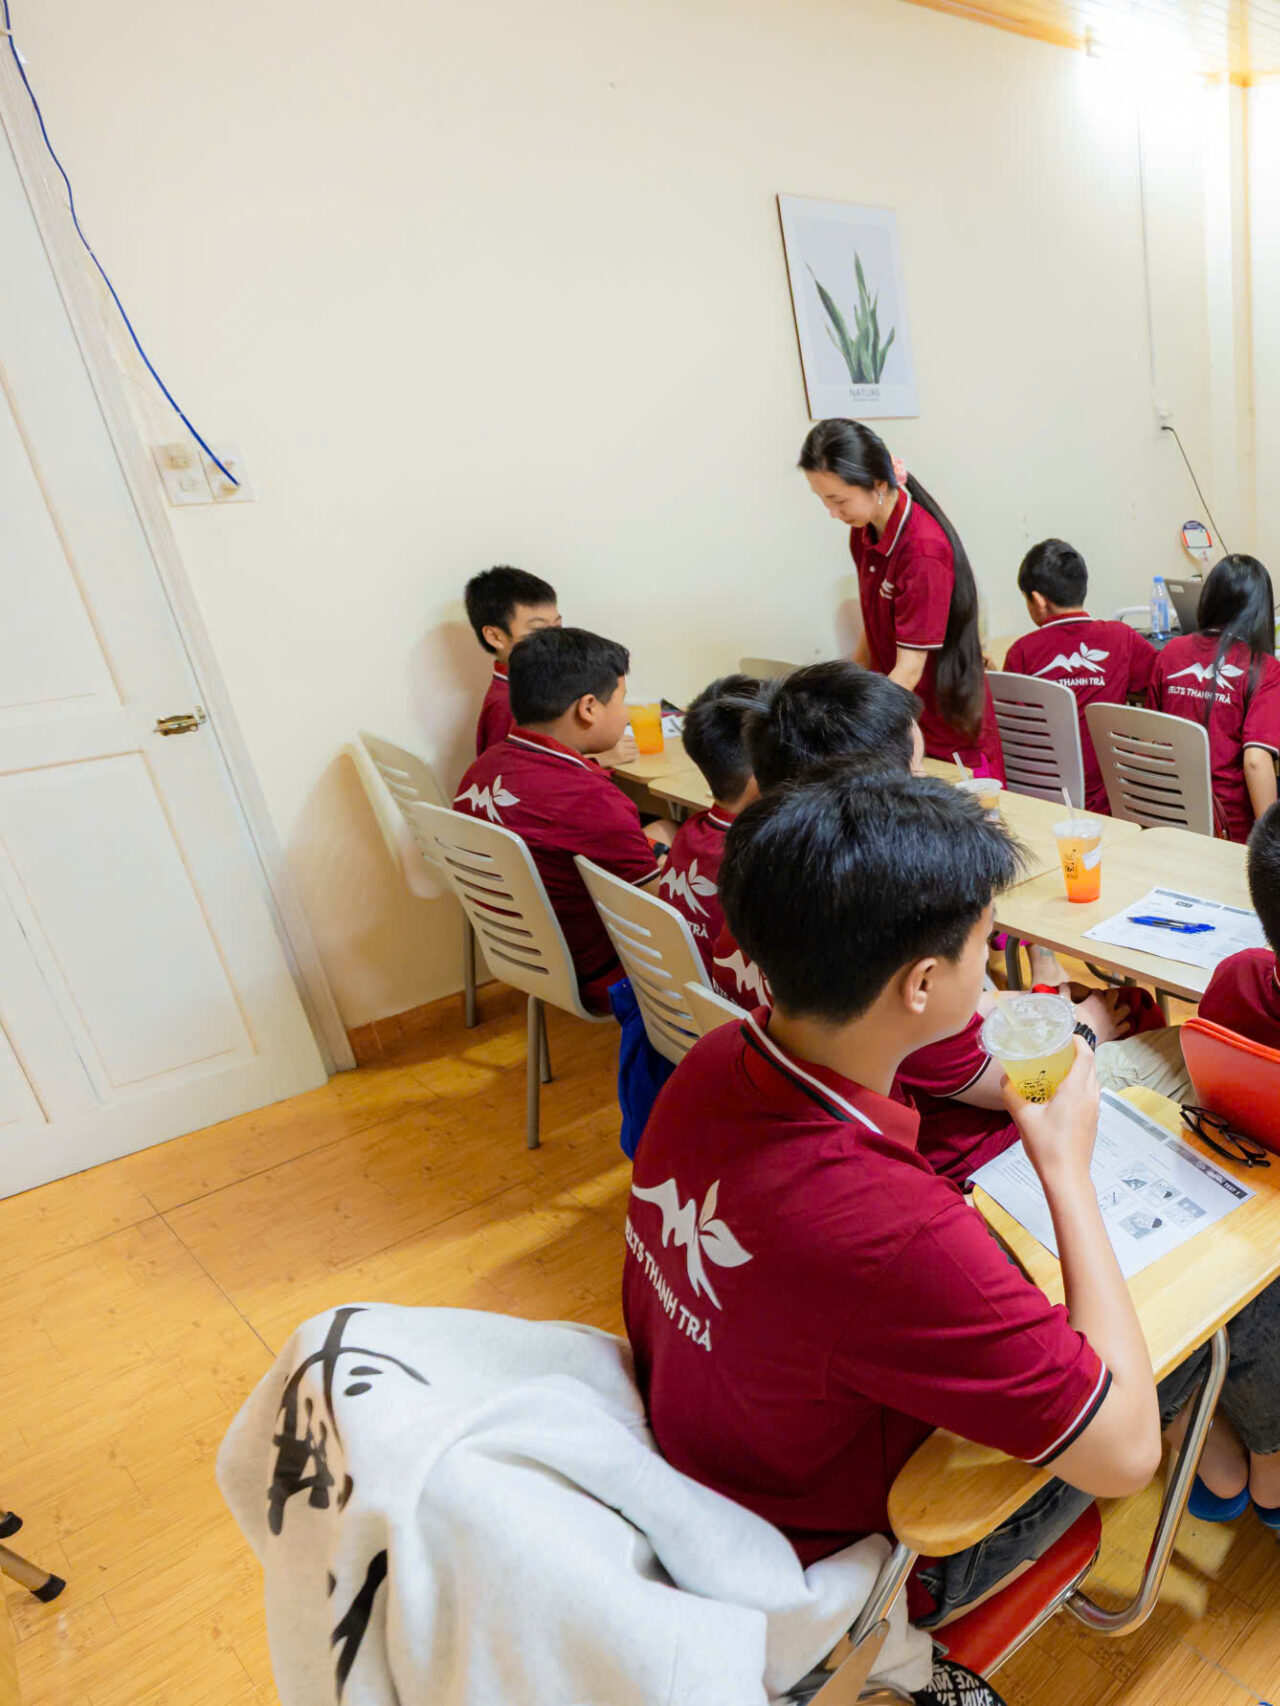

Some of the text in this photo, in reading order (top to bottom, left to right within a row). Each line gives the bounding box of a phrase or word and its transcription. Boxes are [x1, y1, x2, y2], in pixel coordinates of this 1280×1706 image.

[1059, 677, 1088, 686] THANH
[1215, 692, 1231, 704] TRÀ
[644, 1250, 678, 1319] THANH
[678, 1304, 712, 1352] TRÀ
